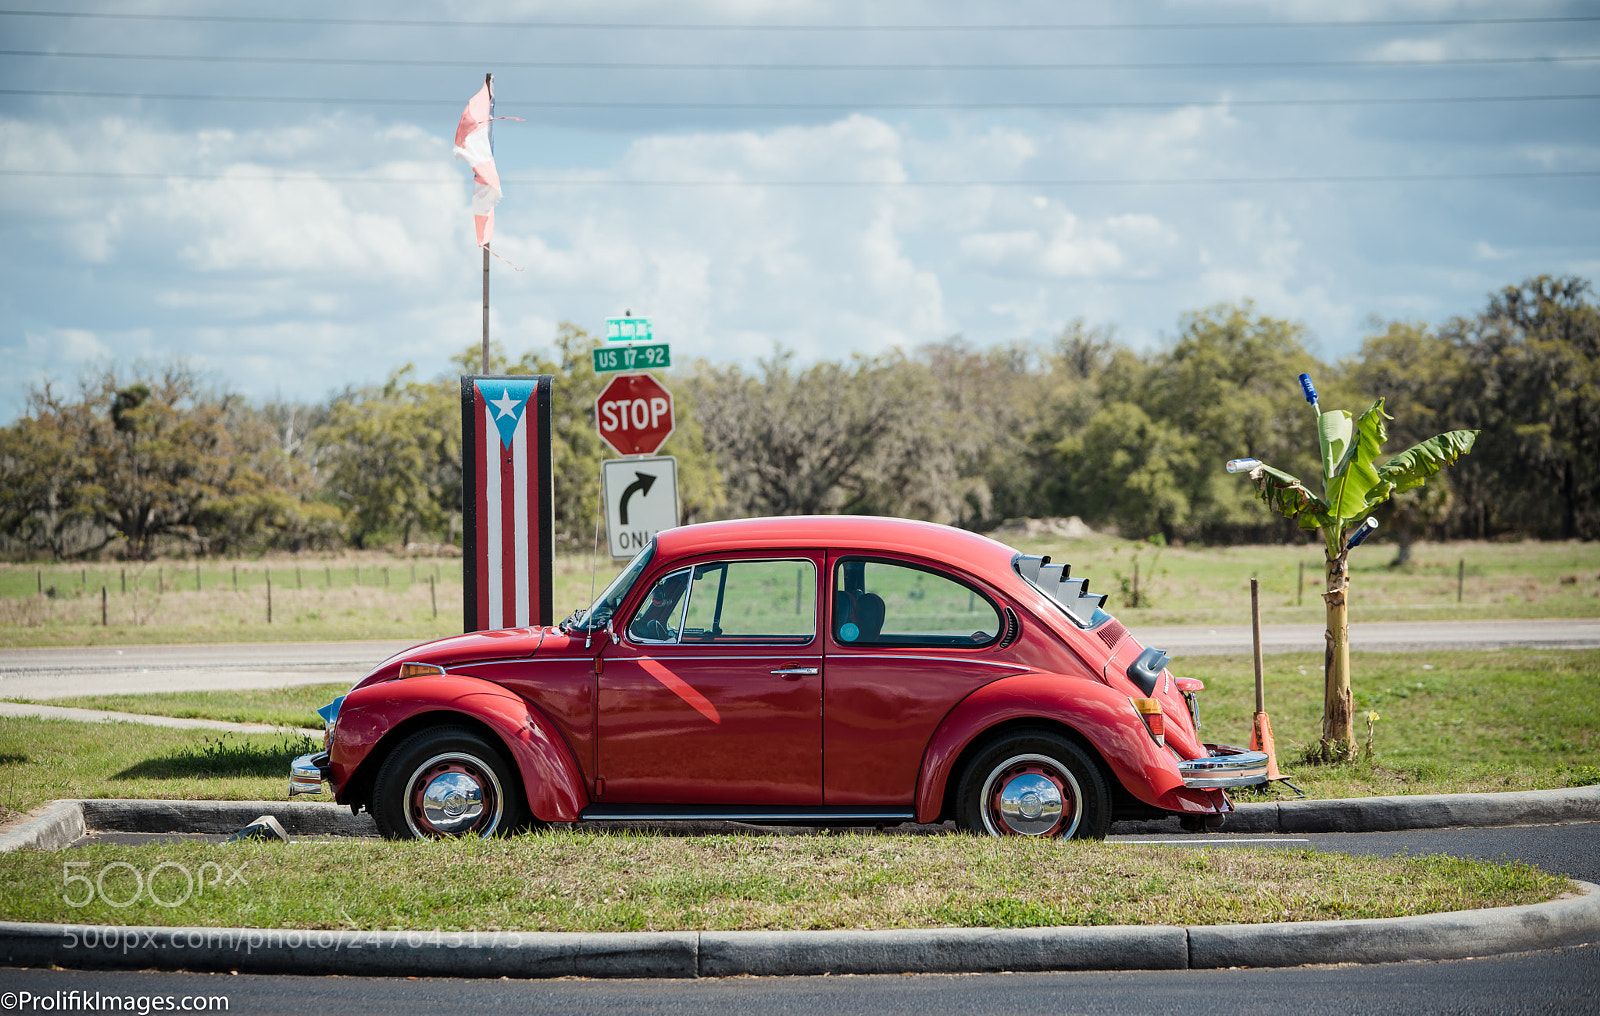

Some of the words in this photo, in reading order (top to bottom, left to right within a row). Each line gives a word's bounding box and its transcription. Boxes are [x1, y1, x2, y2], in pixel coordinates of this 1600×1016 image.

[599, 351, 617, 368] US
[624, 347, 665, 366] 17-92
[602, 397, 668, 432] STOP
[619, 530, 659, 549] ONL
